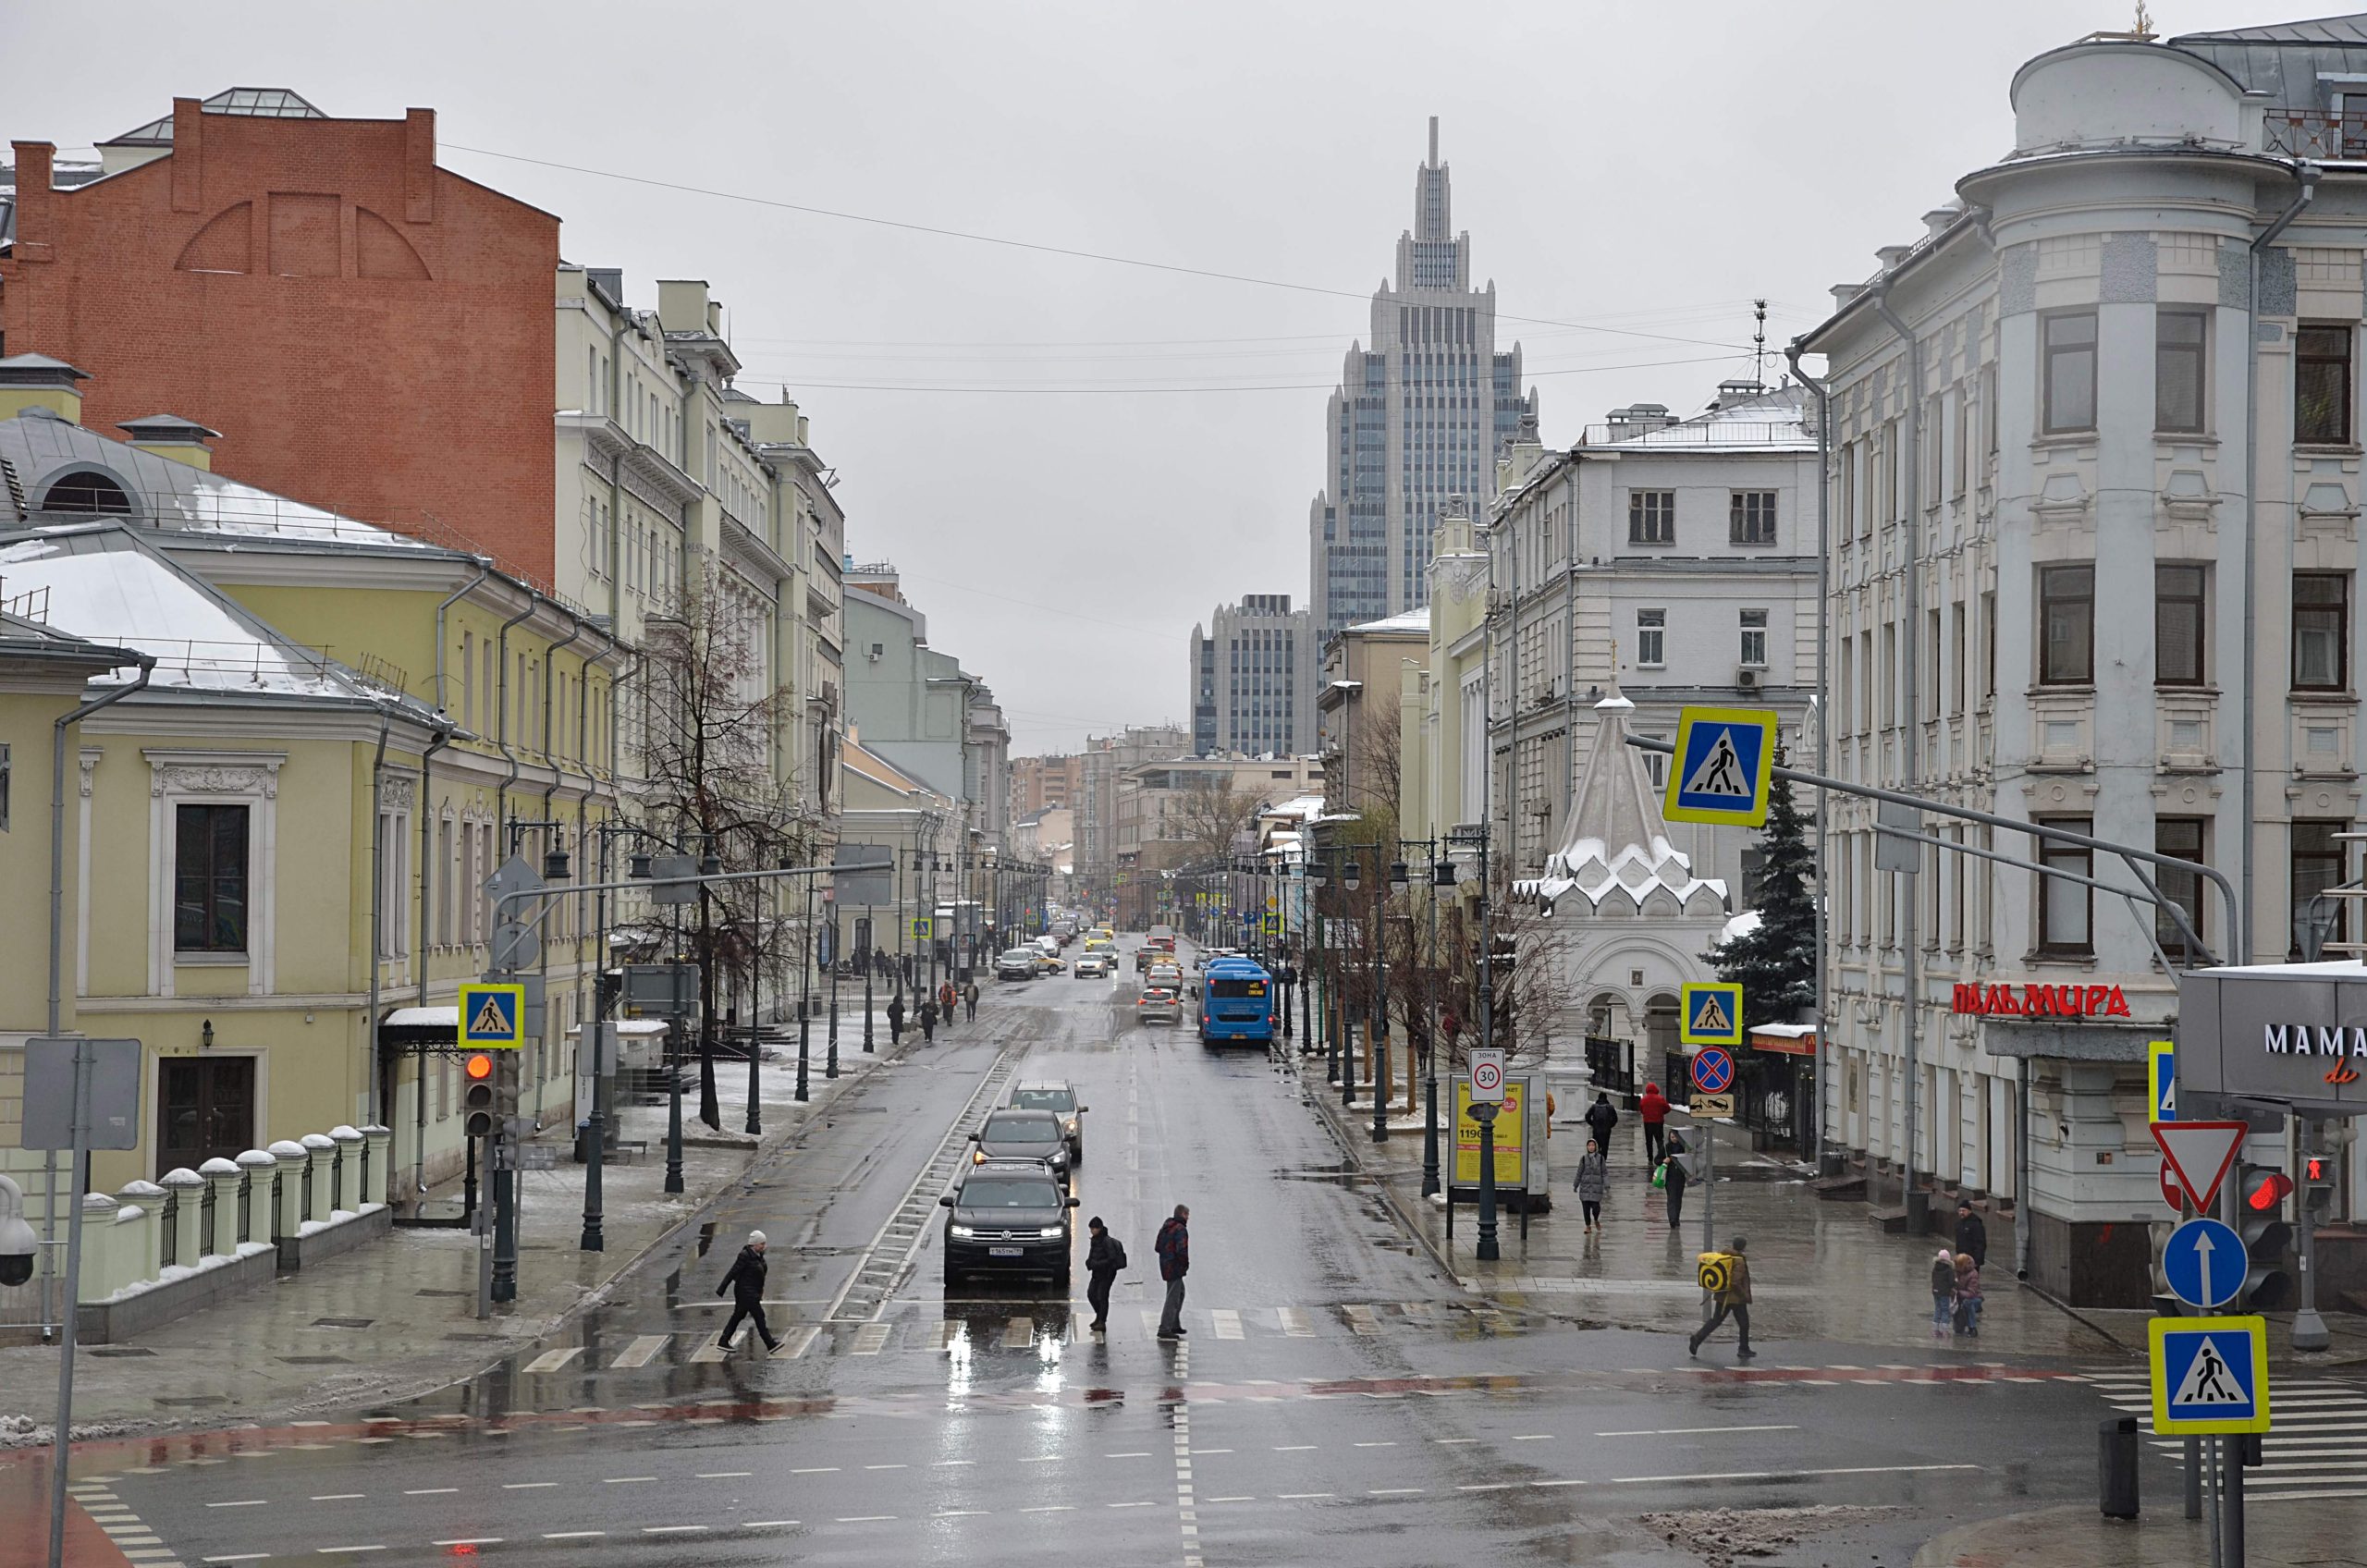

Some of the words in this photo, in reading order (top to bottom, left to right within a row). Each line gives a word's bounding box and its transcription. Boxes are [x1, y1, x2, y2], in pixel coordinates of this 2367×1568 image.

[1953, 982, 2130, 1017] ПАЛЬМИРА
[2264, 1024, 2367, 1057] MAMA
[1479, 1072, 1495, 1082] 30
